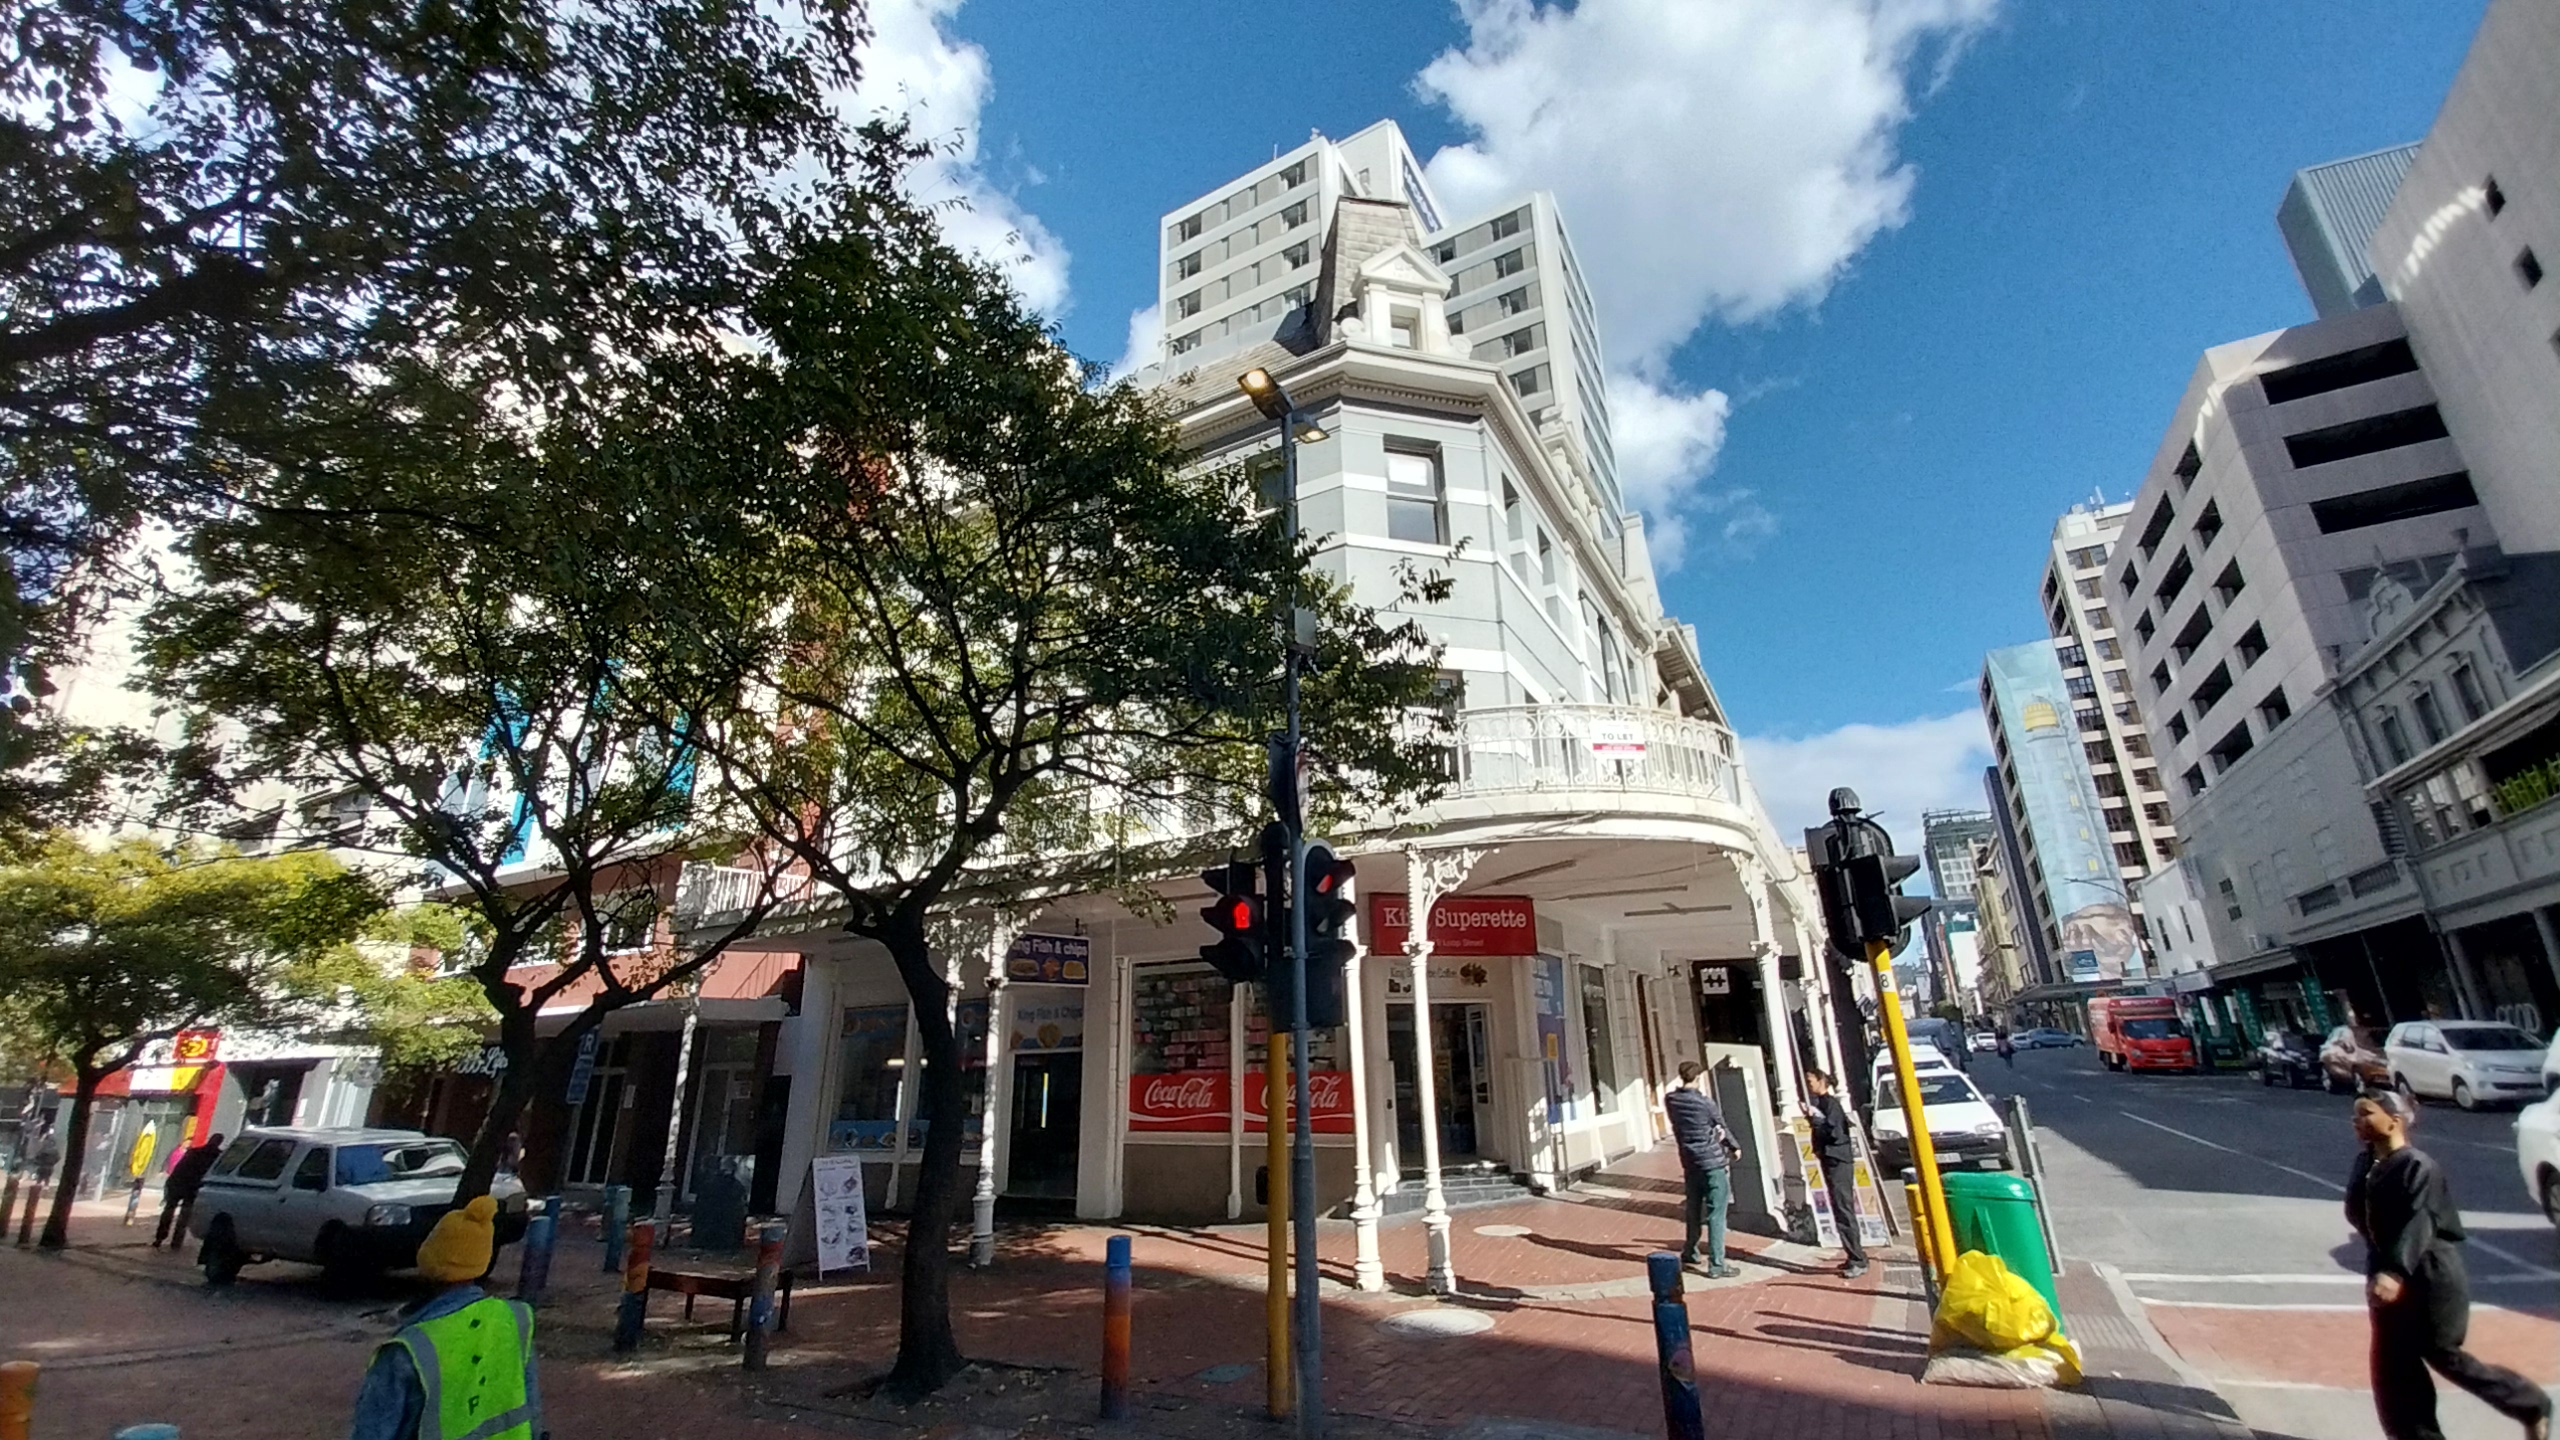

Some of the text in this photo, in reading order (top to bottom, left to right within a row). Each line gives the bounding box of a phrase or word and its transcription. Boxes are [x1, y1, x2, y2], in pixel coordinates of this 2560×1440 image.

[1435, 907, 1527, 931] Superette
[1032, 939, 1054, 953] Fish
[1063, 942, 1088, 958] chips
[1880, 973, 1890, 988] 8
[1144, 1077, 1217, 1110] Coca-Cola
[1261, 1075, 1342, 1110] CaCola
